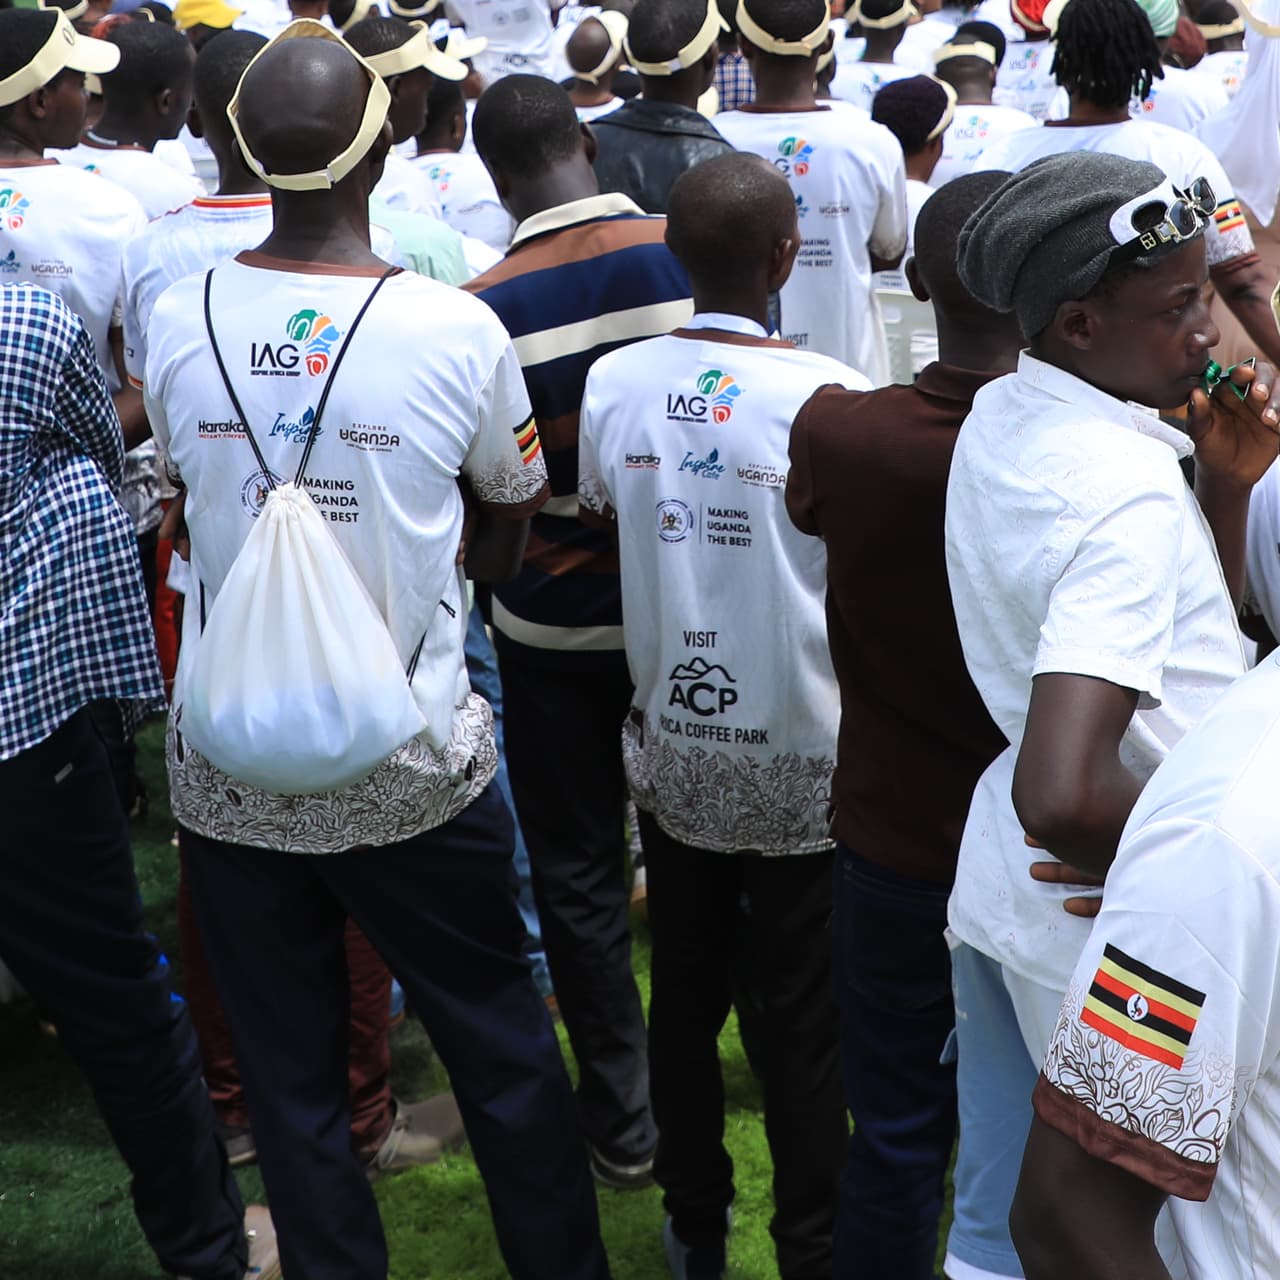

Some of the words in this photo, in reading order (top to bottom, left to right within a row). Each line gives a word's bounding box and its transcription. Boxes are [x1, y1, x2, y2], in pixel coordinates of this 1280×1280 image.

[250, 343, 300, 369] IAG
[667, 393, 708, 417] IAG
[339, 428, 400, 447] UGANDA
[678, 452, 726, 476] Inspire
[737, 468, 786, 486] UGANDA
[303, 477, 355, 491] MAKING
[310, 494, 359, 507] GANDA
[330, 511, 359, 523] BEST
[707, 506, 749, 520] MAKING
[707, 520, 752, 535] UGANDA
[707, 534, 727, 546] THE
[729, 536, 752, 548] BEST
[683, 630, 718, 648] VISIT
[668, 681, 738, 717] ACP
[685, 722, 732, 743] COFFEE
[735, 728, 769, 745] PARK
